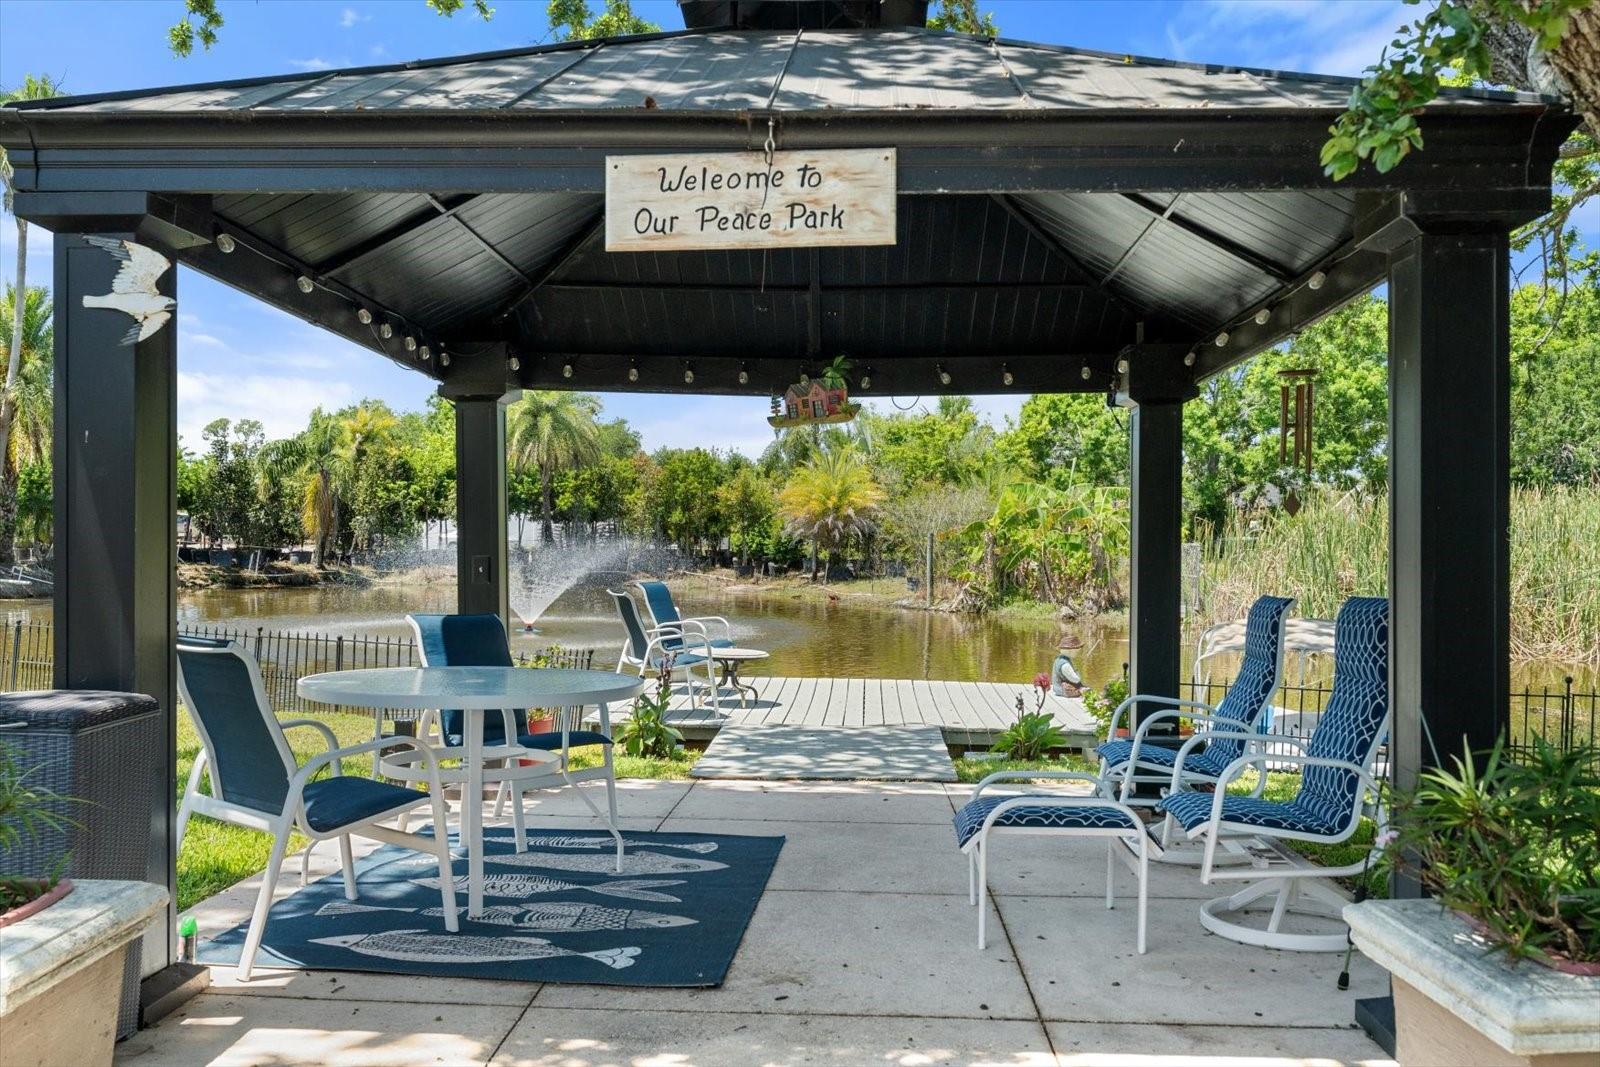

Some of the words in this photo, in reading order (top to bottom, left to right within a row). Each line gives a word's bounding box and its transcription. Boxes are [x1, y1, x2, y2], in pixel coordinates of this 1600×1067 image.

[797, 164, 823, 189] to
[634, 207, 680, 235] Our
[694, 205, 773, 232] Peace
[785, 202, 846, 231] Park
